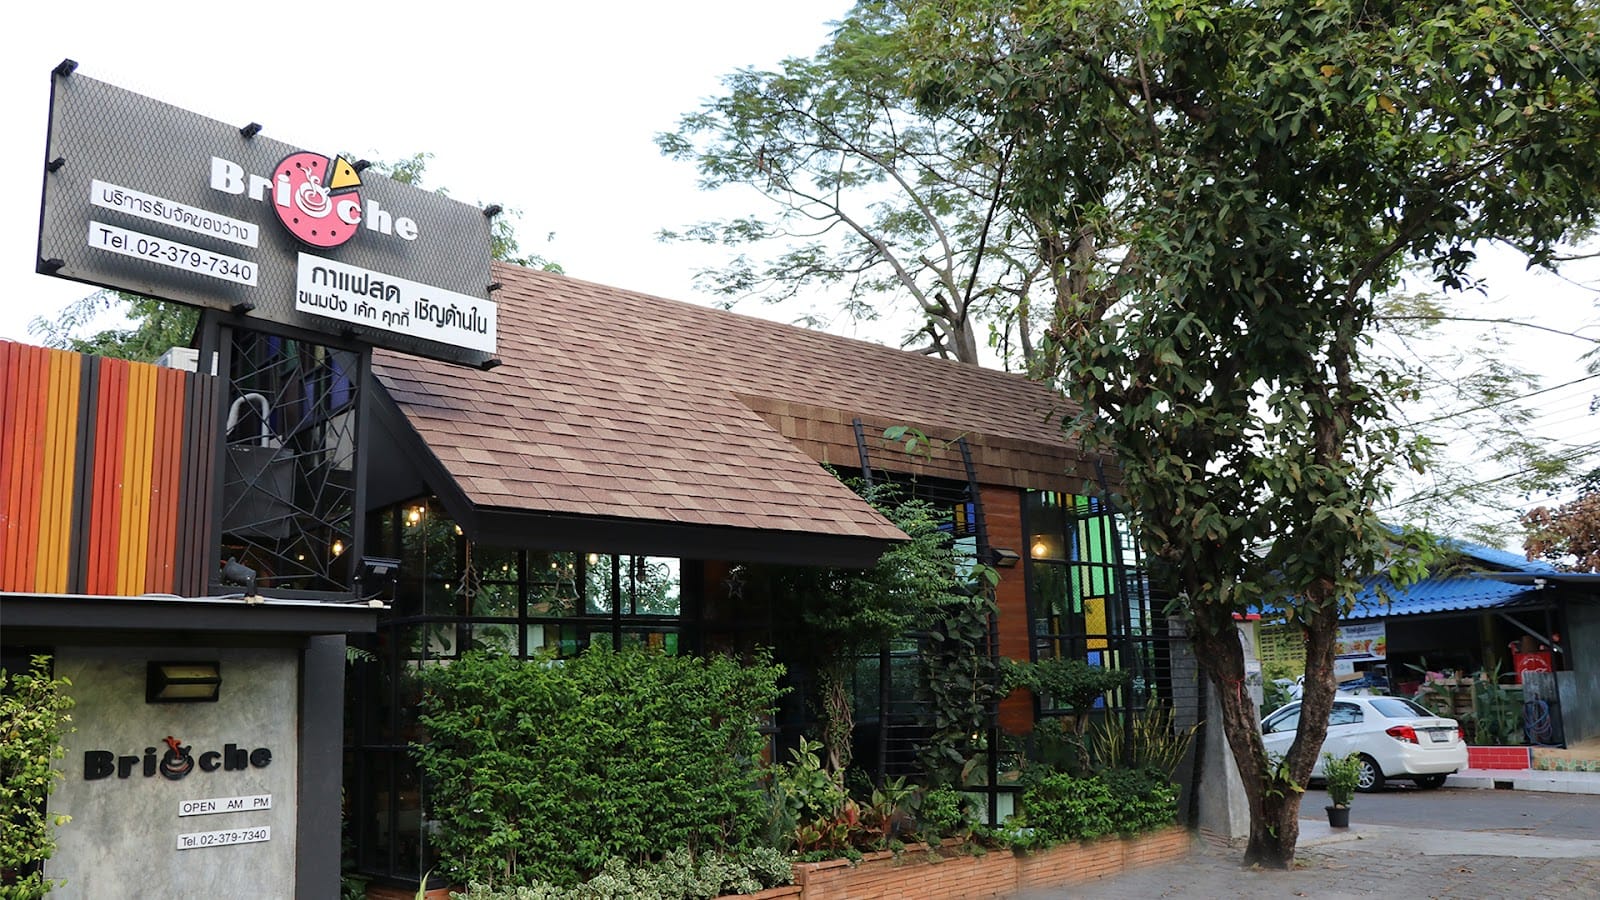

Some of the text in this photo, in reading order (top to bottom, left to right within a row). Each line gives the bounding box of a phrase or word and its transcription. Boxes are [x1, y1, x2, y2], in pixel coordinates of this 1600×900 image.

[103, 188, 249, 240] บริการรับจัดของว่าง
[210, 156, 419, 240] Brioche
[311, 266, 401, 304] กาแฟสด
[298, 291, 348, 313] ขนมปัง
[353, 301, 377, 320] เค้ก
[414, 298, 487, 334] เชิญด้านใน
[84, 742, 272, 780] Brioche
[183, 797, 269, 813] OPEN AM PM
